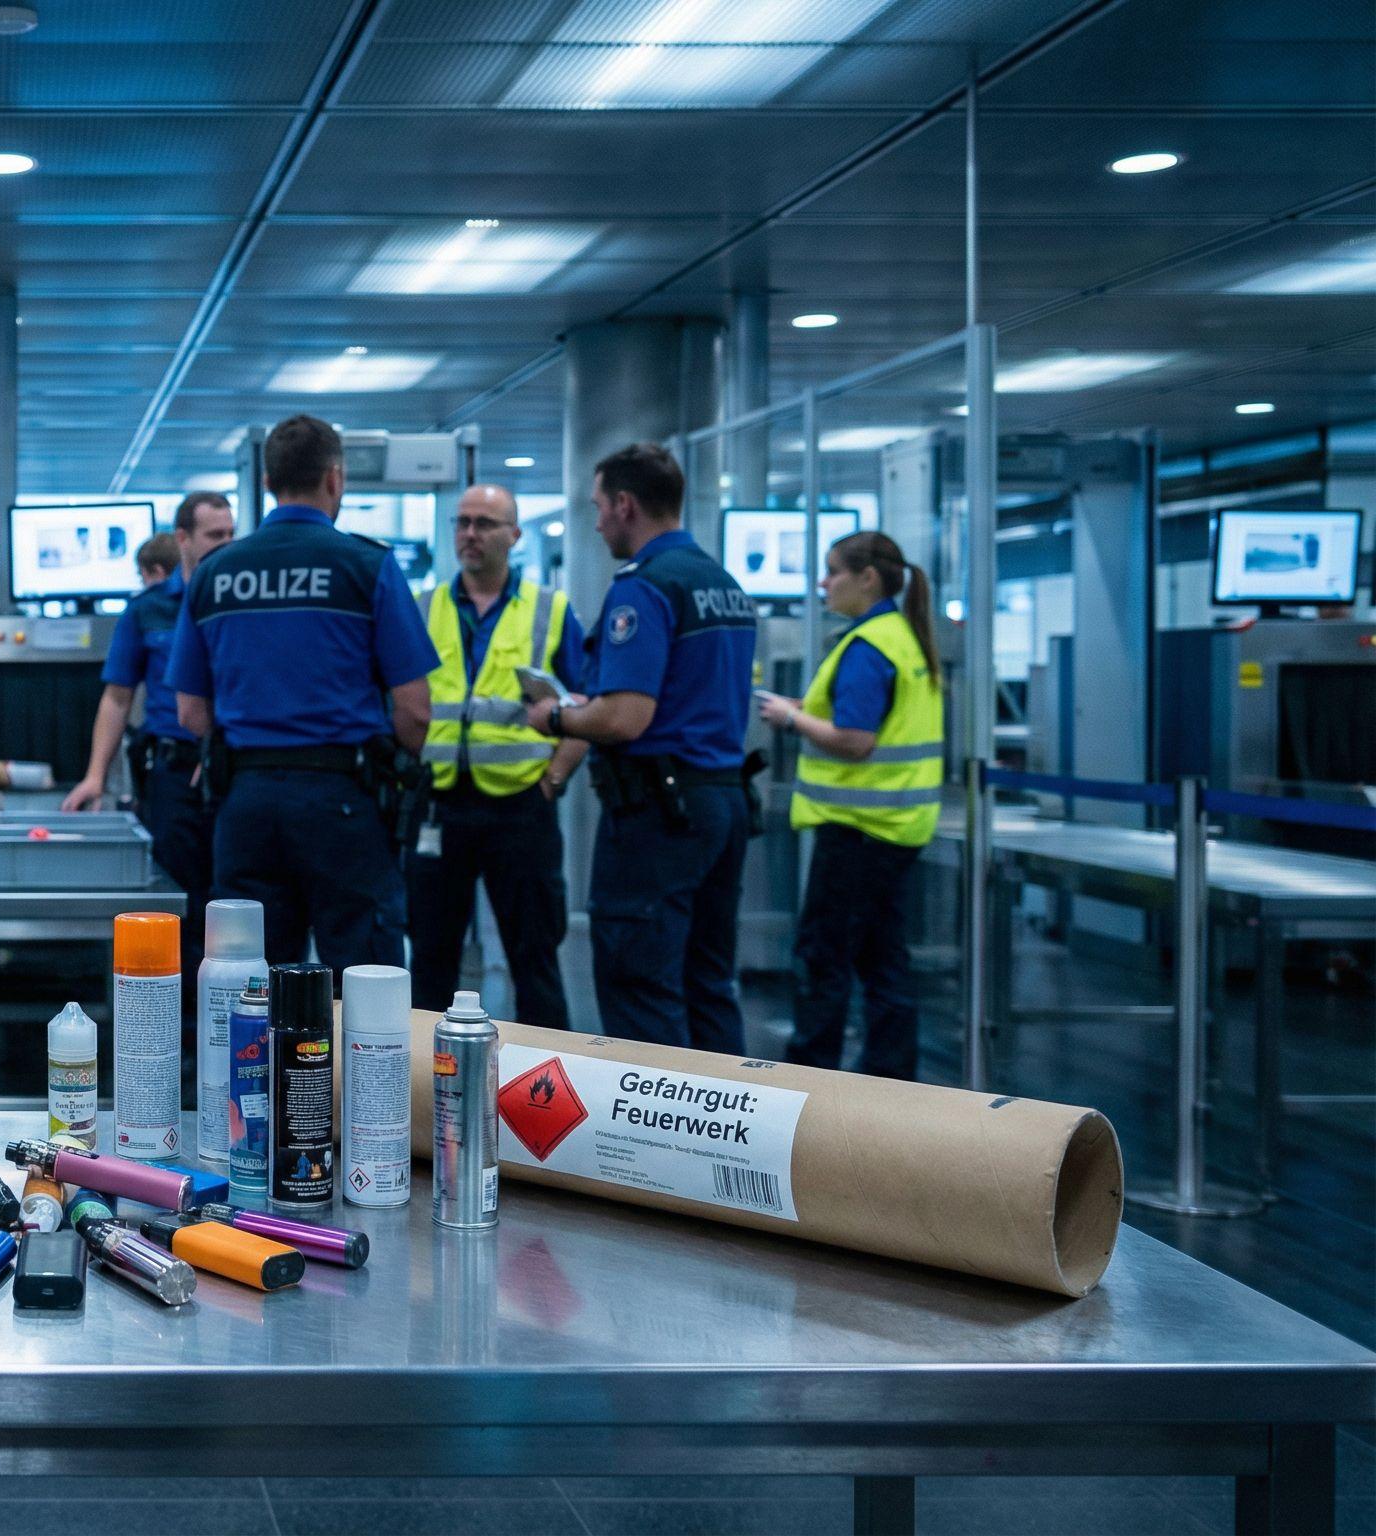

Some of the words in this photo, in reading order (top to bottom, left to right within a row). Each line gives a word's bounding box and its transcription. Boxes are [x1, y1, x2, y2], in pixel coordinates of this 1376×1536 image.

[214, 568, 332, 603] POLIZE
[619, 1072, 758, 1114] Gefahrgut:
[611, 1099, 750, 1145] Feuerwerk
